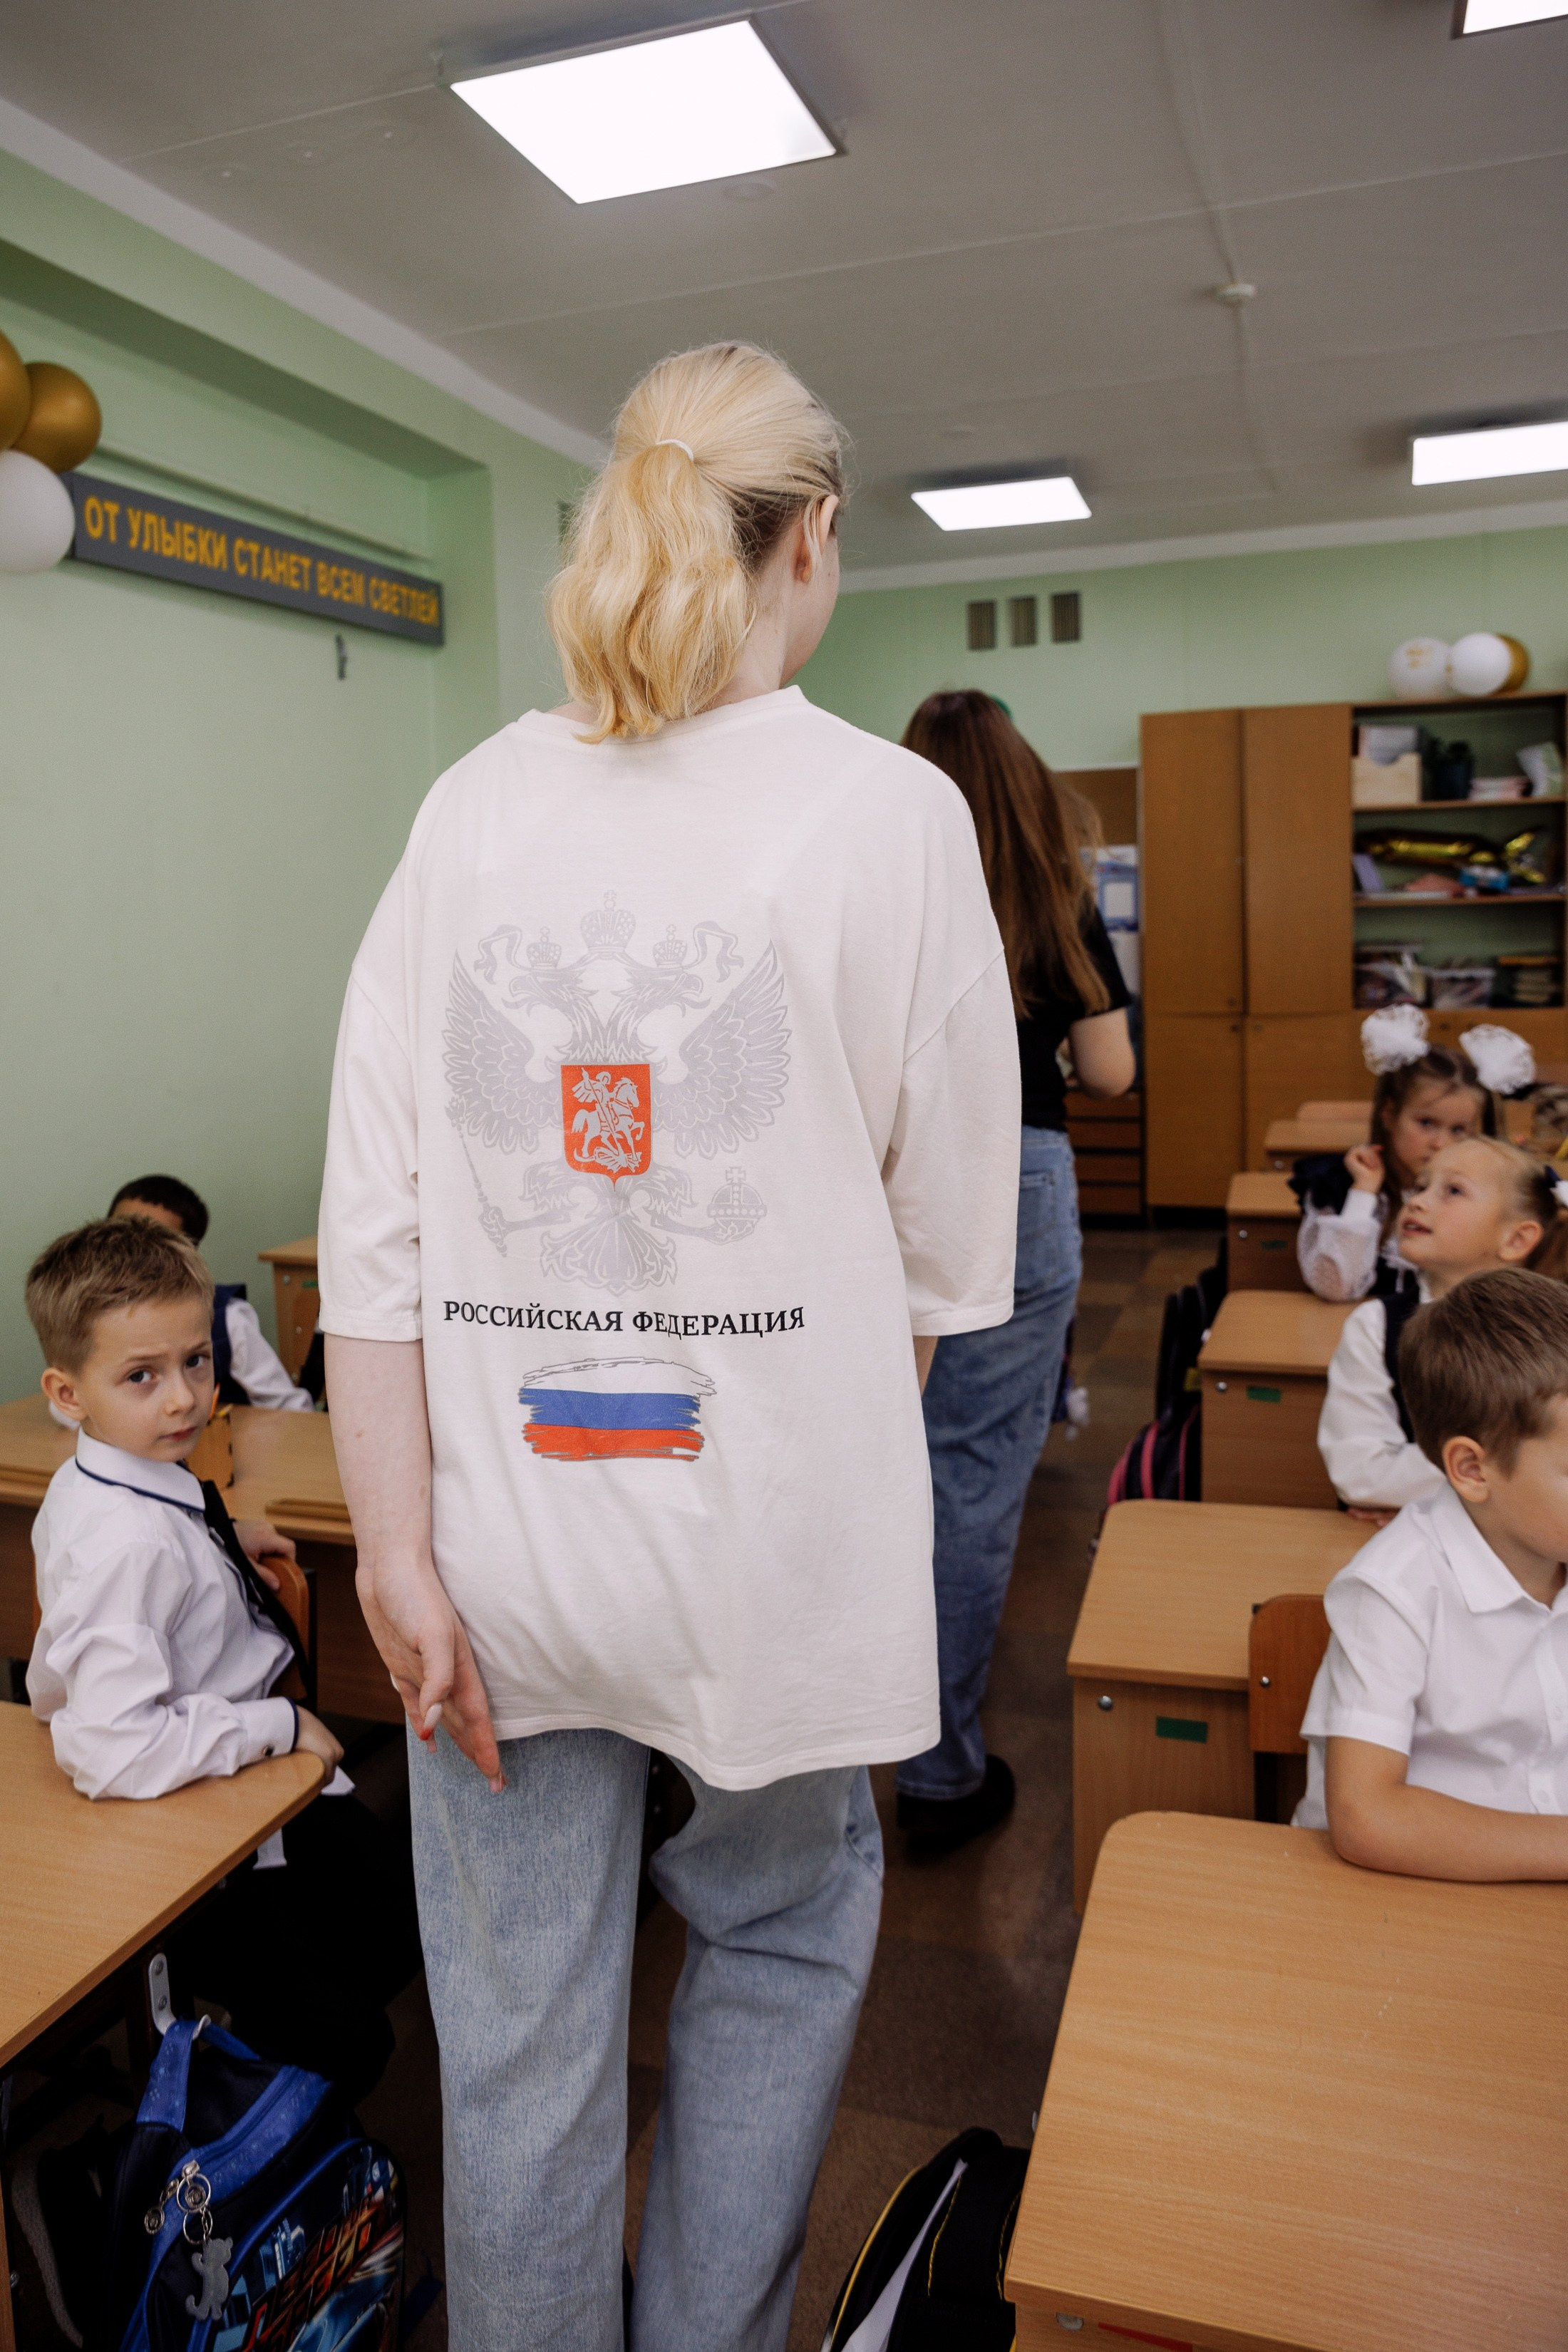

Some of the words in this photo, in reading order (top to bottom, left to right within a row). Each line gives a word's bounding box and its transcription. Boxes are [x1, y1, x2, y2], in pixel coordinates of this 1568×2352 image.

[84, 496, 120, 543] ОТ
[127, 507, 228, 570] УЛЫБКИ
[232, 537, 312, 591] СТАНЕТ
[316, 561, 366, 606] ВСЕМ
[368, 577, 439, 626] СВЕТЛЕЙ
[443, 1301, 624, 1332] РОССИЙСКАЯ
[632, 1306, 805, 1340] ФЕДЕРАЦИЯ
